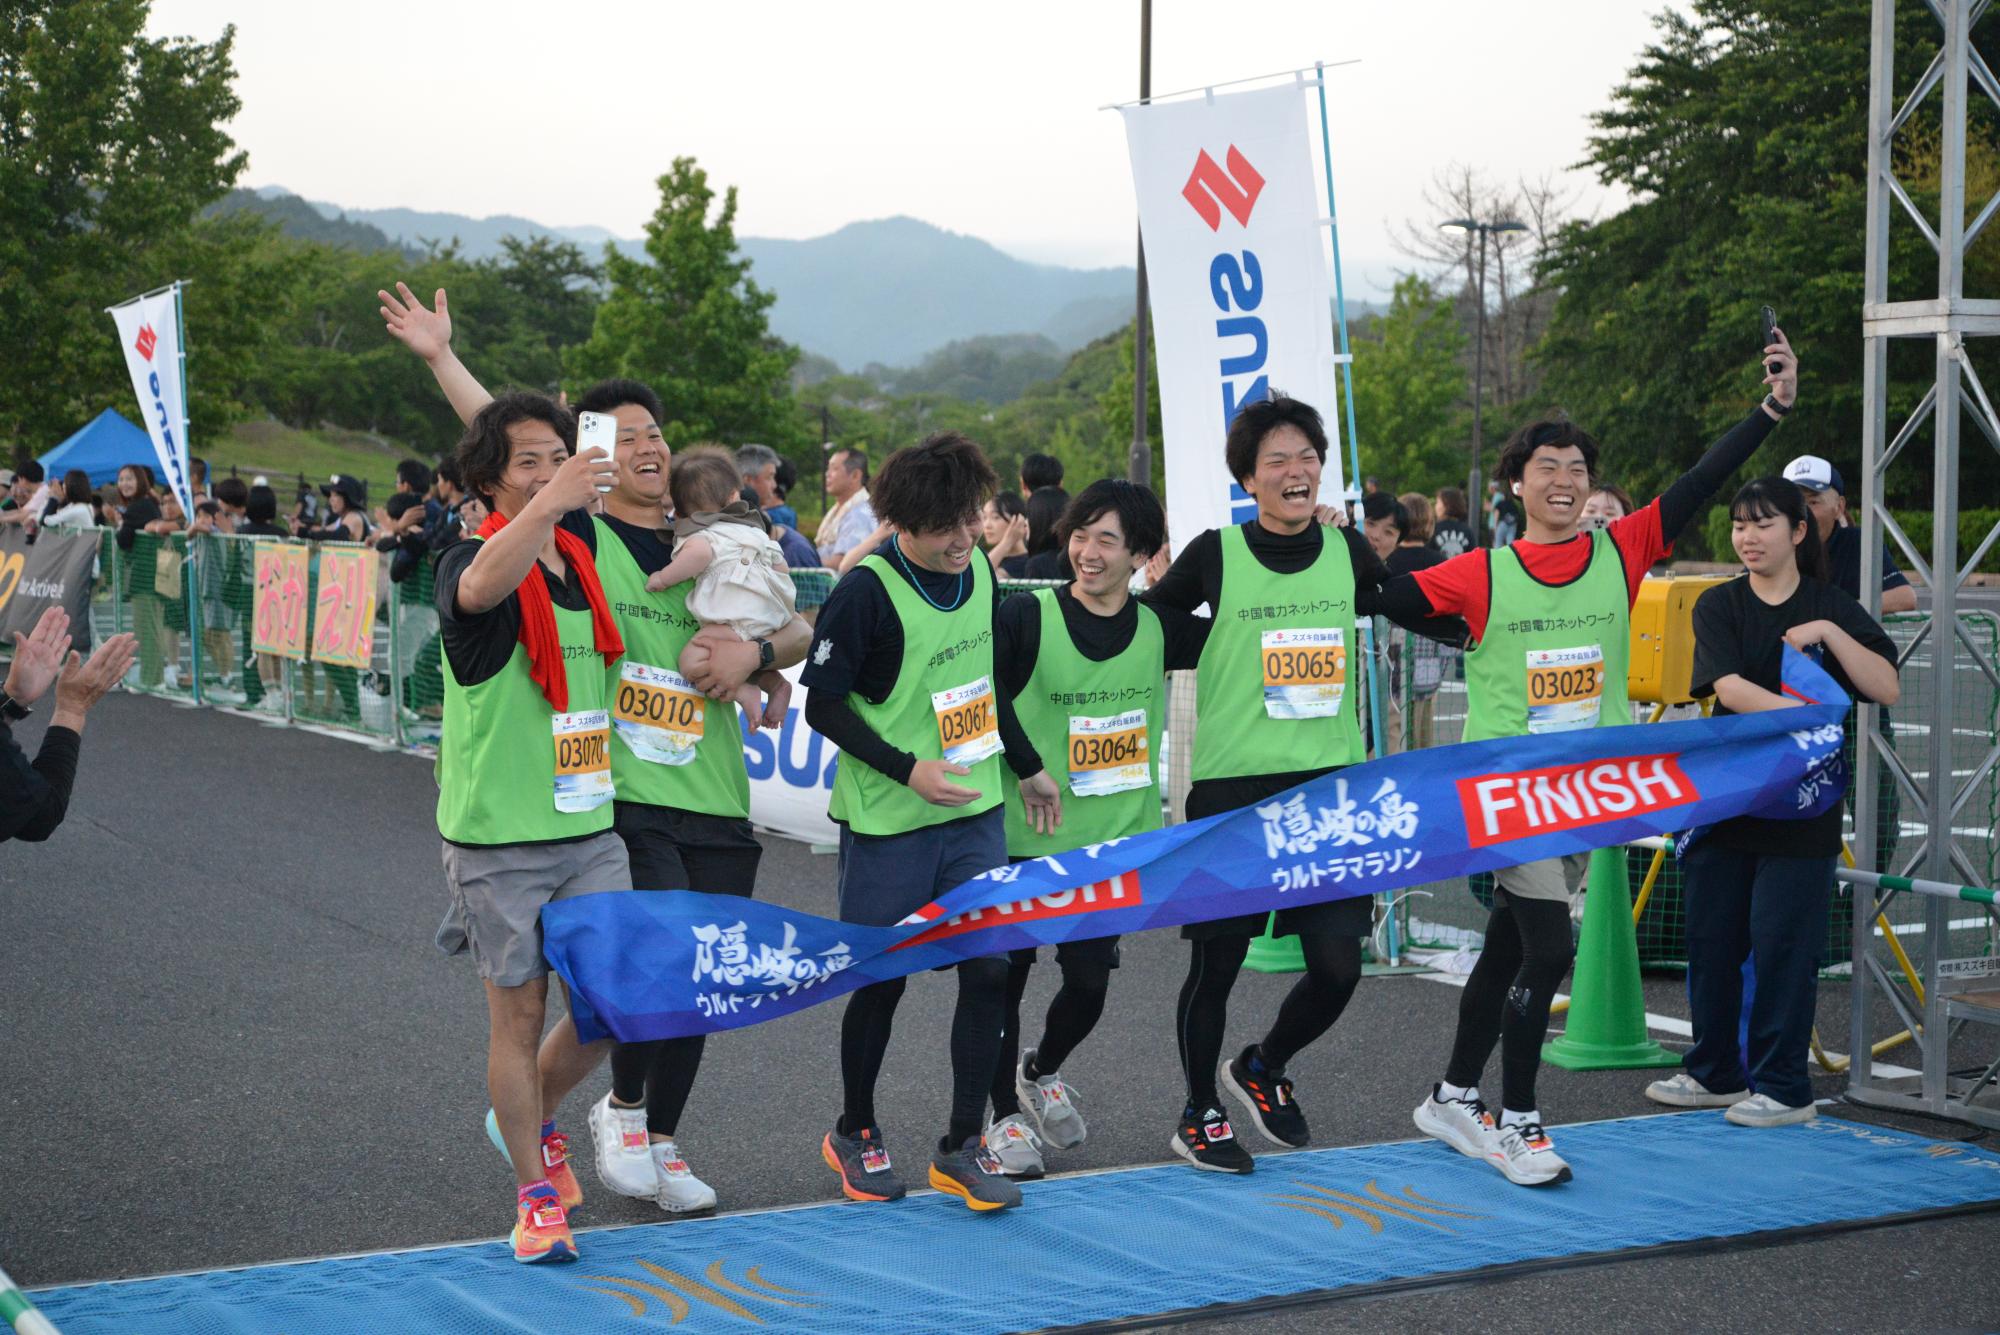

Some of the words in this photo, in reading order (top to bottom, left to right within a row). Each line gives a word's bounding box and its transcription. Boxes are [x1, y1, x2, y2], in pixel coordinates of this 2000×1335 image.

[1238, 599, 1347, 621] 中国電力ネットワーク
[1507, 612, 1615, 634] 中国電力ネットワーク
[1267, 650, 1335, 680] 03065
[1050, 687, 1152, 705] 中国電力ネットワーク
[1531, 667, 1596, 699] 03023
[619, 685, 695, 727] 03010
[942, 701, 988, 743] 03061
[559, 734, 604, 768] 03070
[739, 703, 839, 789] SU
[1073, 733, 1138, 766] 03064
[1475, 758, 1683, 836] FINISH
[1255, 777, 1419, 859] 隠岐の島
[1271, 848, 1422, 892] ウルトラマラソン
